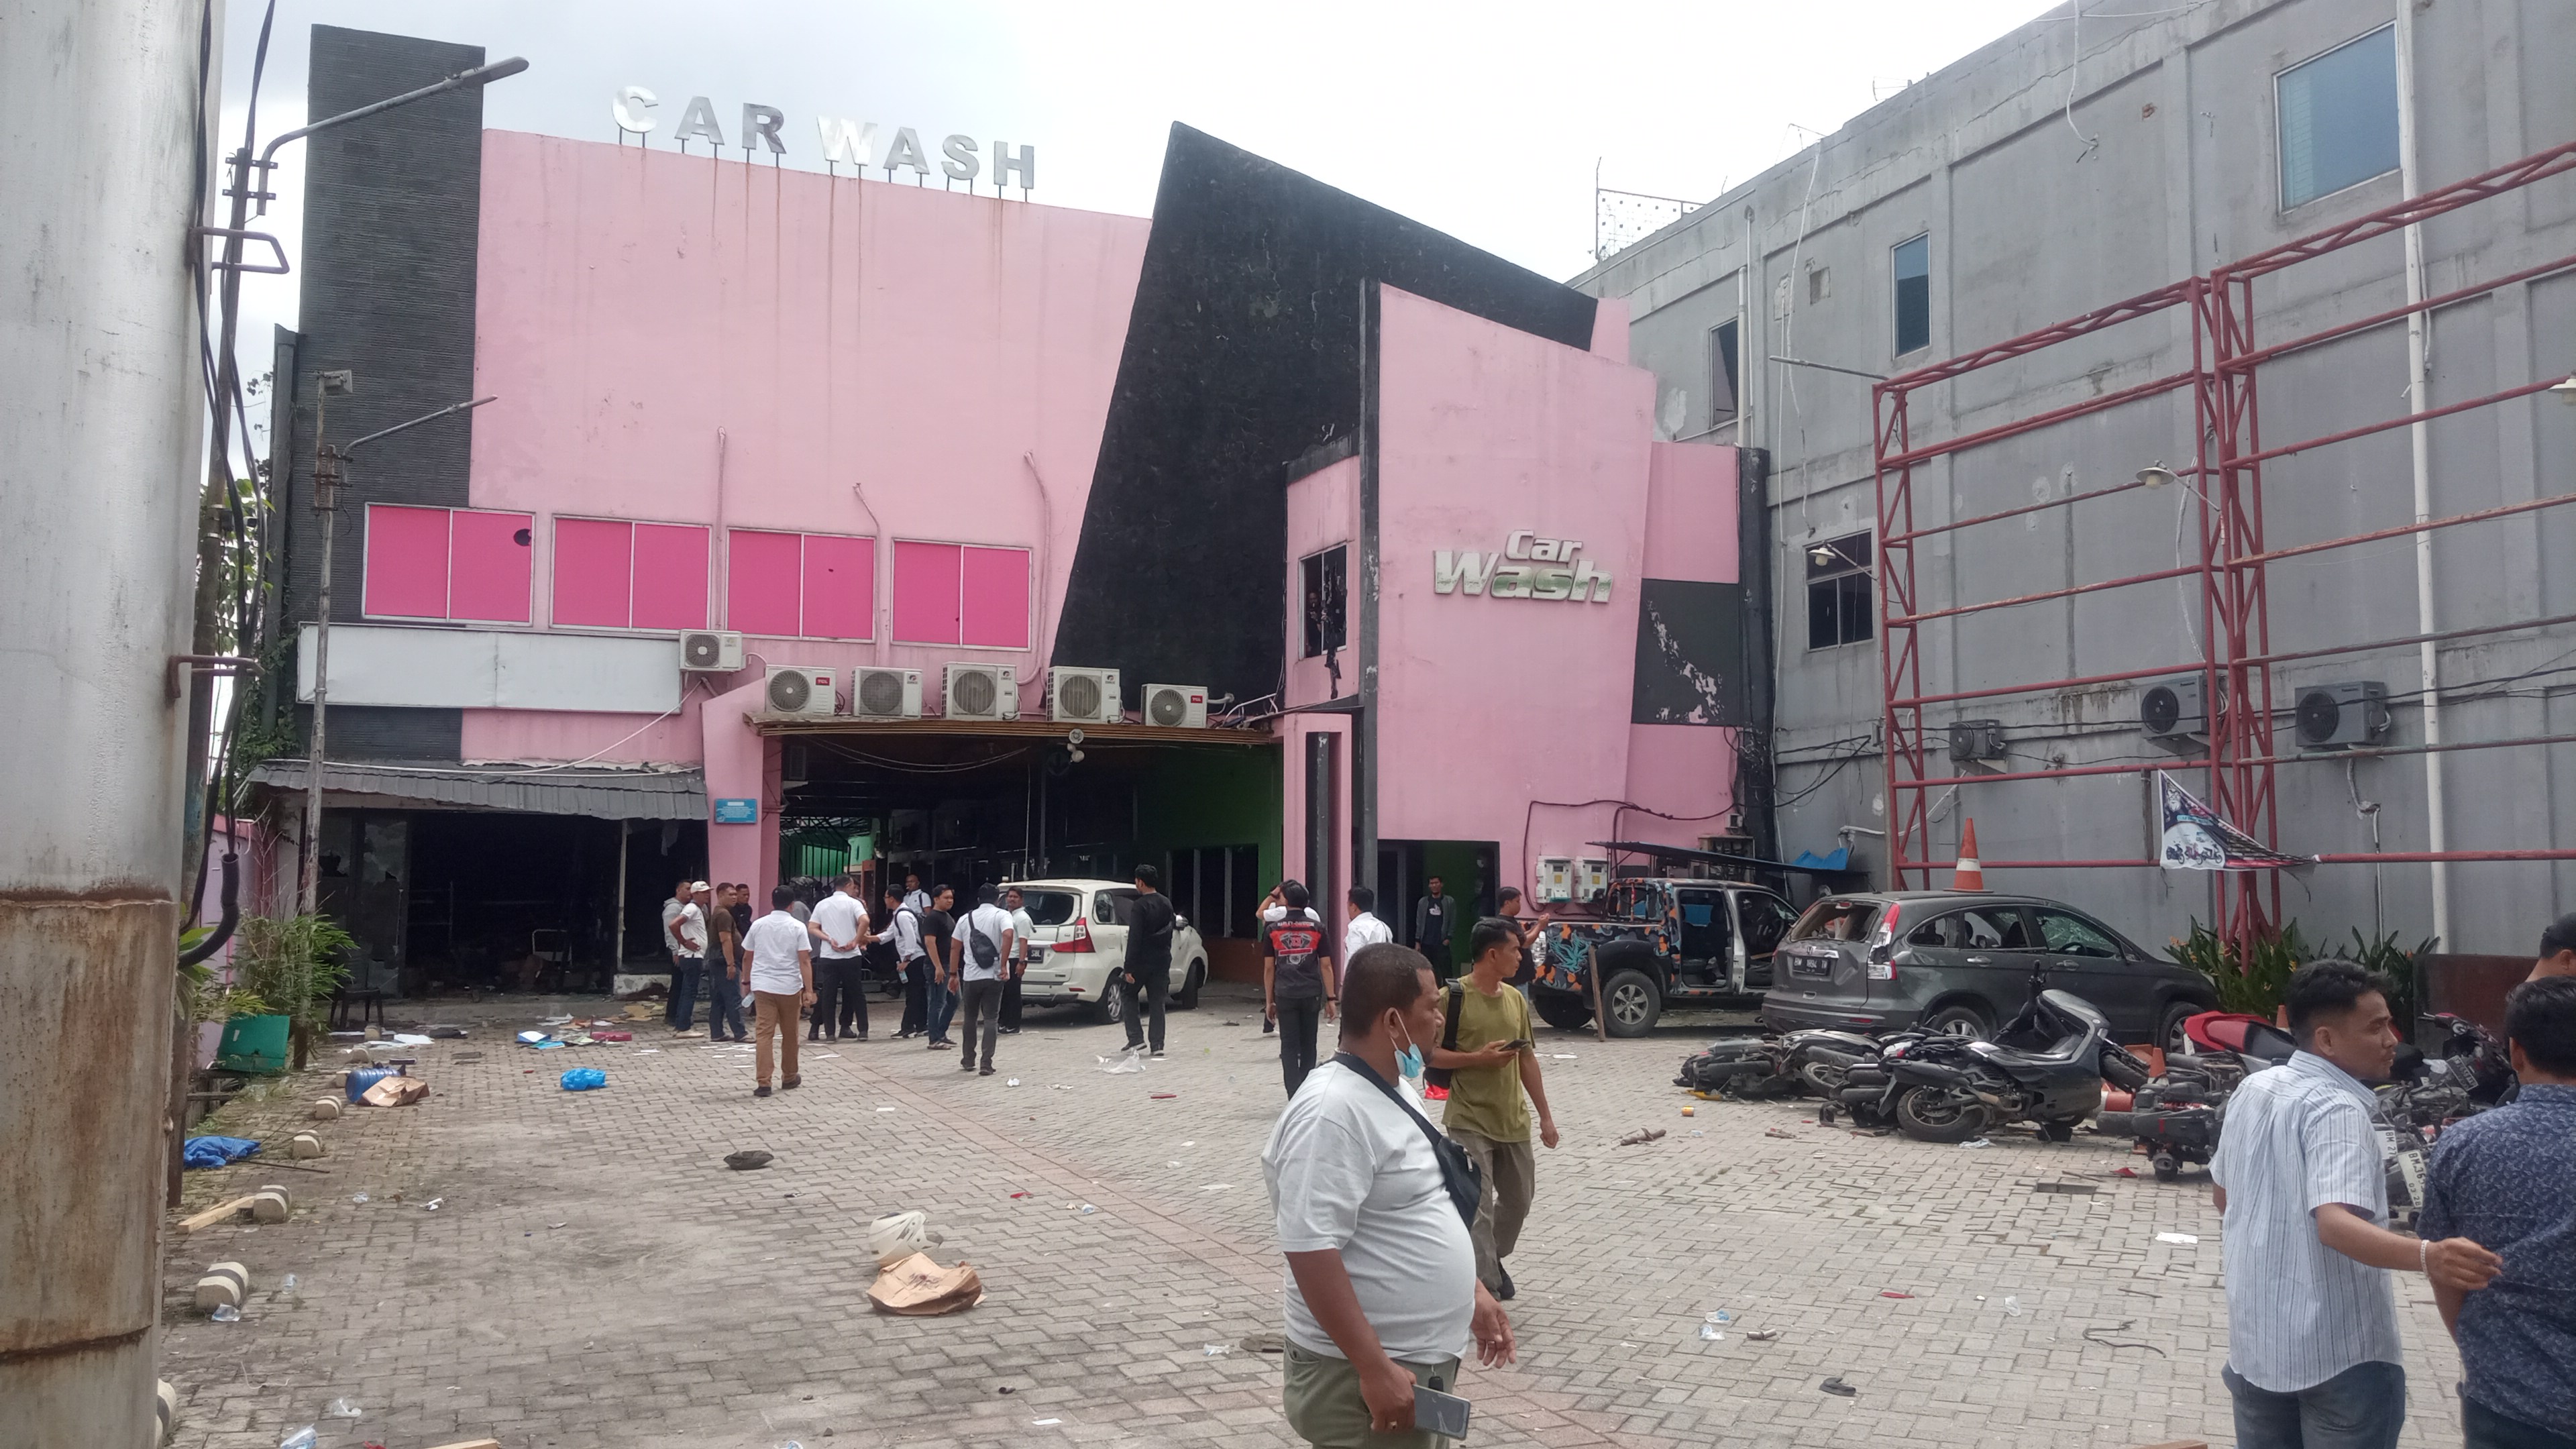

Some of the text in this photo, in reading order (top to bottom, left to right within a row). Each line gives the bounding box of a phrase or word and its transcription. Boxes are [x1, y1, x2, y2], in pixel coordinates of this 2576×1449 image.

[611, 86, 1034, 189] CAR WASH
[1505, 529, 1582, 563] Car
[1434, 549, 1613, 604] Wash
[2385, 1132, 2397, 1159] BM 27
[2408, 1152, 2420, 1166] BM
